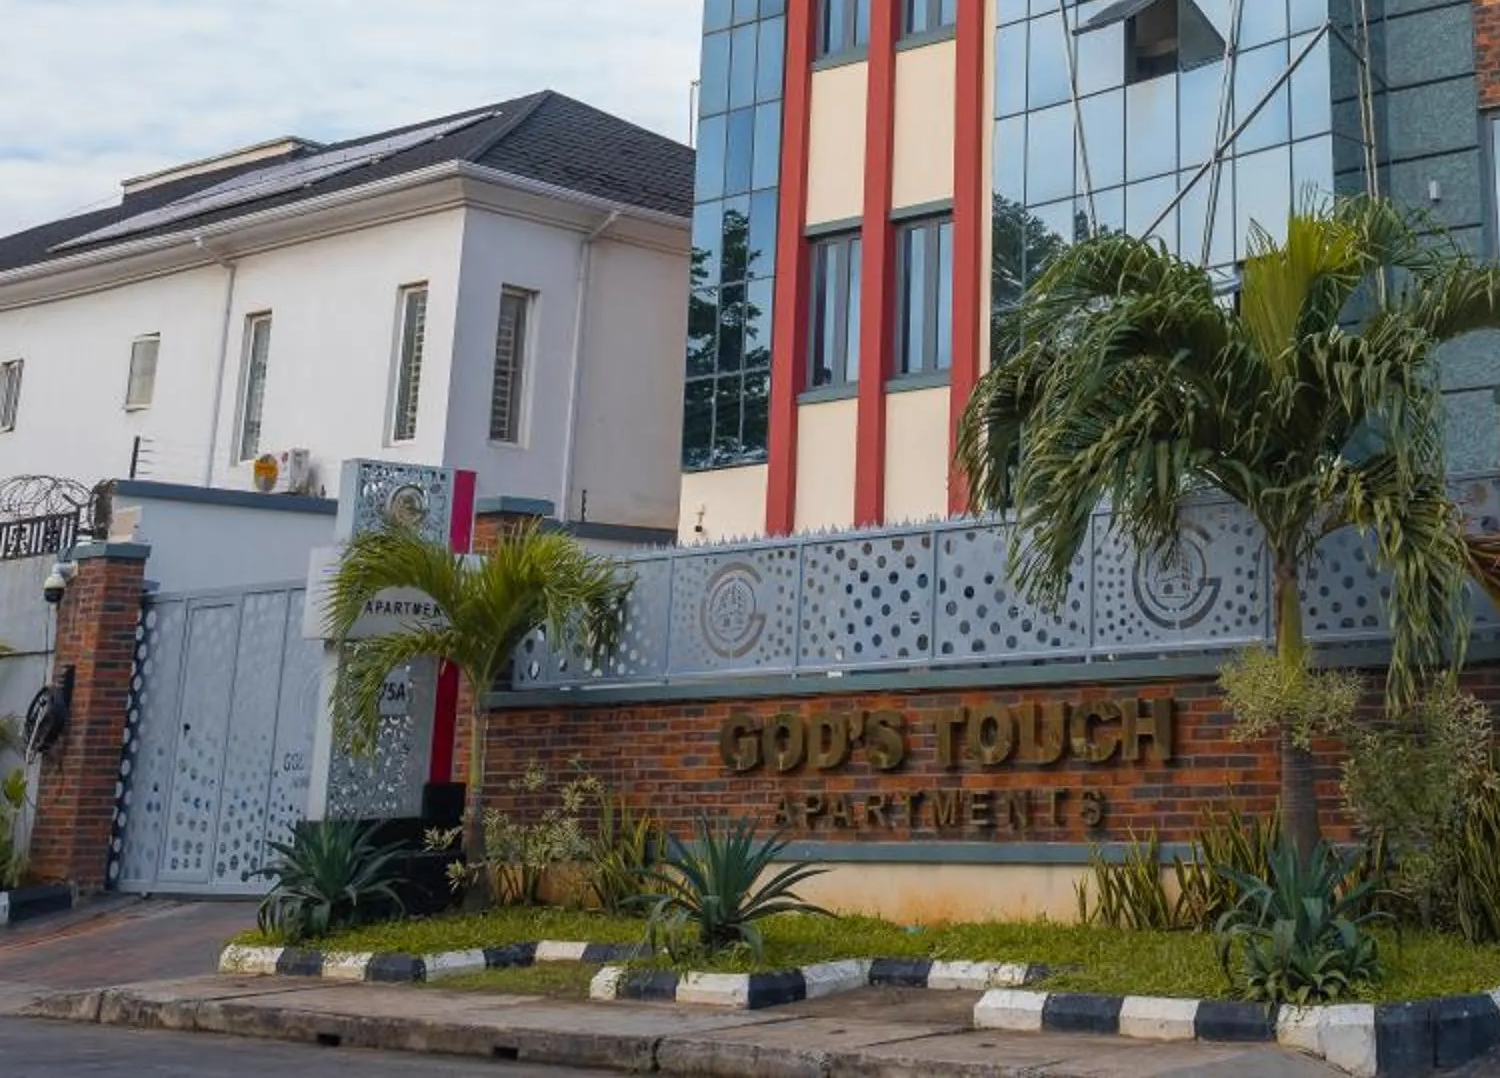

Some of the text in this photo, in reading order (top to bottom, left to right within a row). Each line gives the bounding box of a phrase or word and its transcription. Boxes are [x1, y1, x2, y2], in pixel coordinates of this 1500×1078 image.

[718, 698, 1175, 771] GOD'S TOUCH
[775, 788, 1106, 829] APARTMENTS
